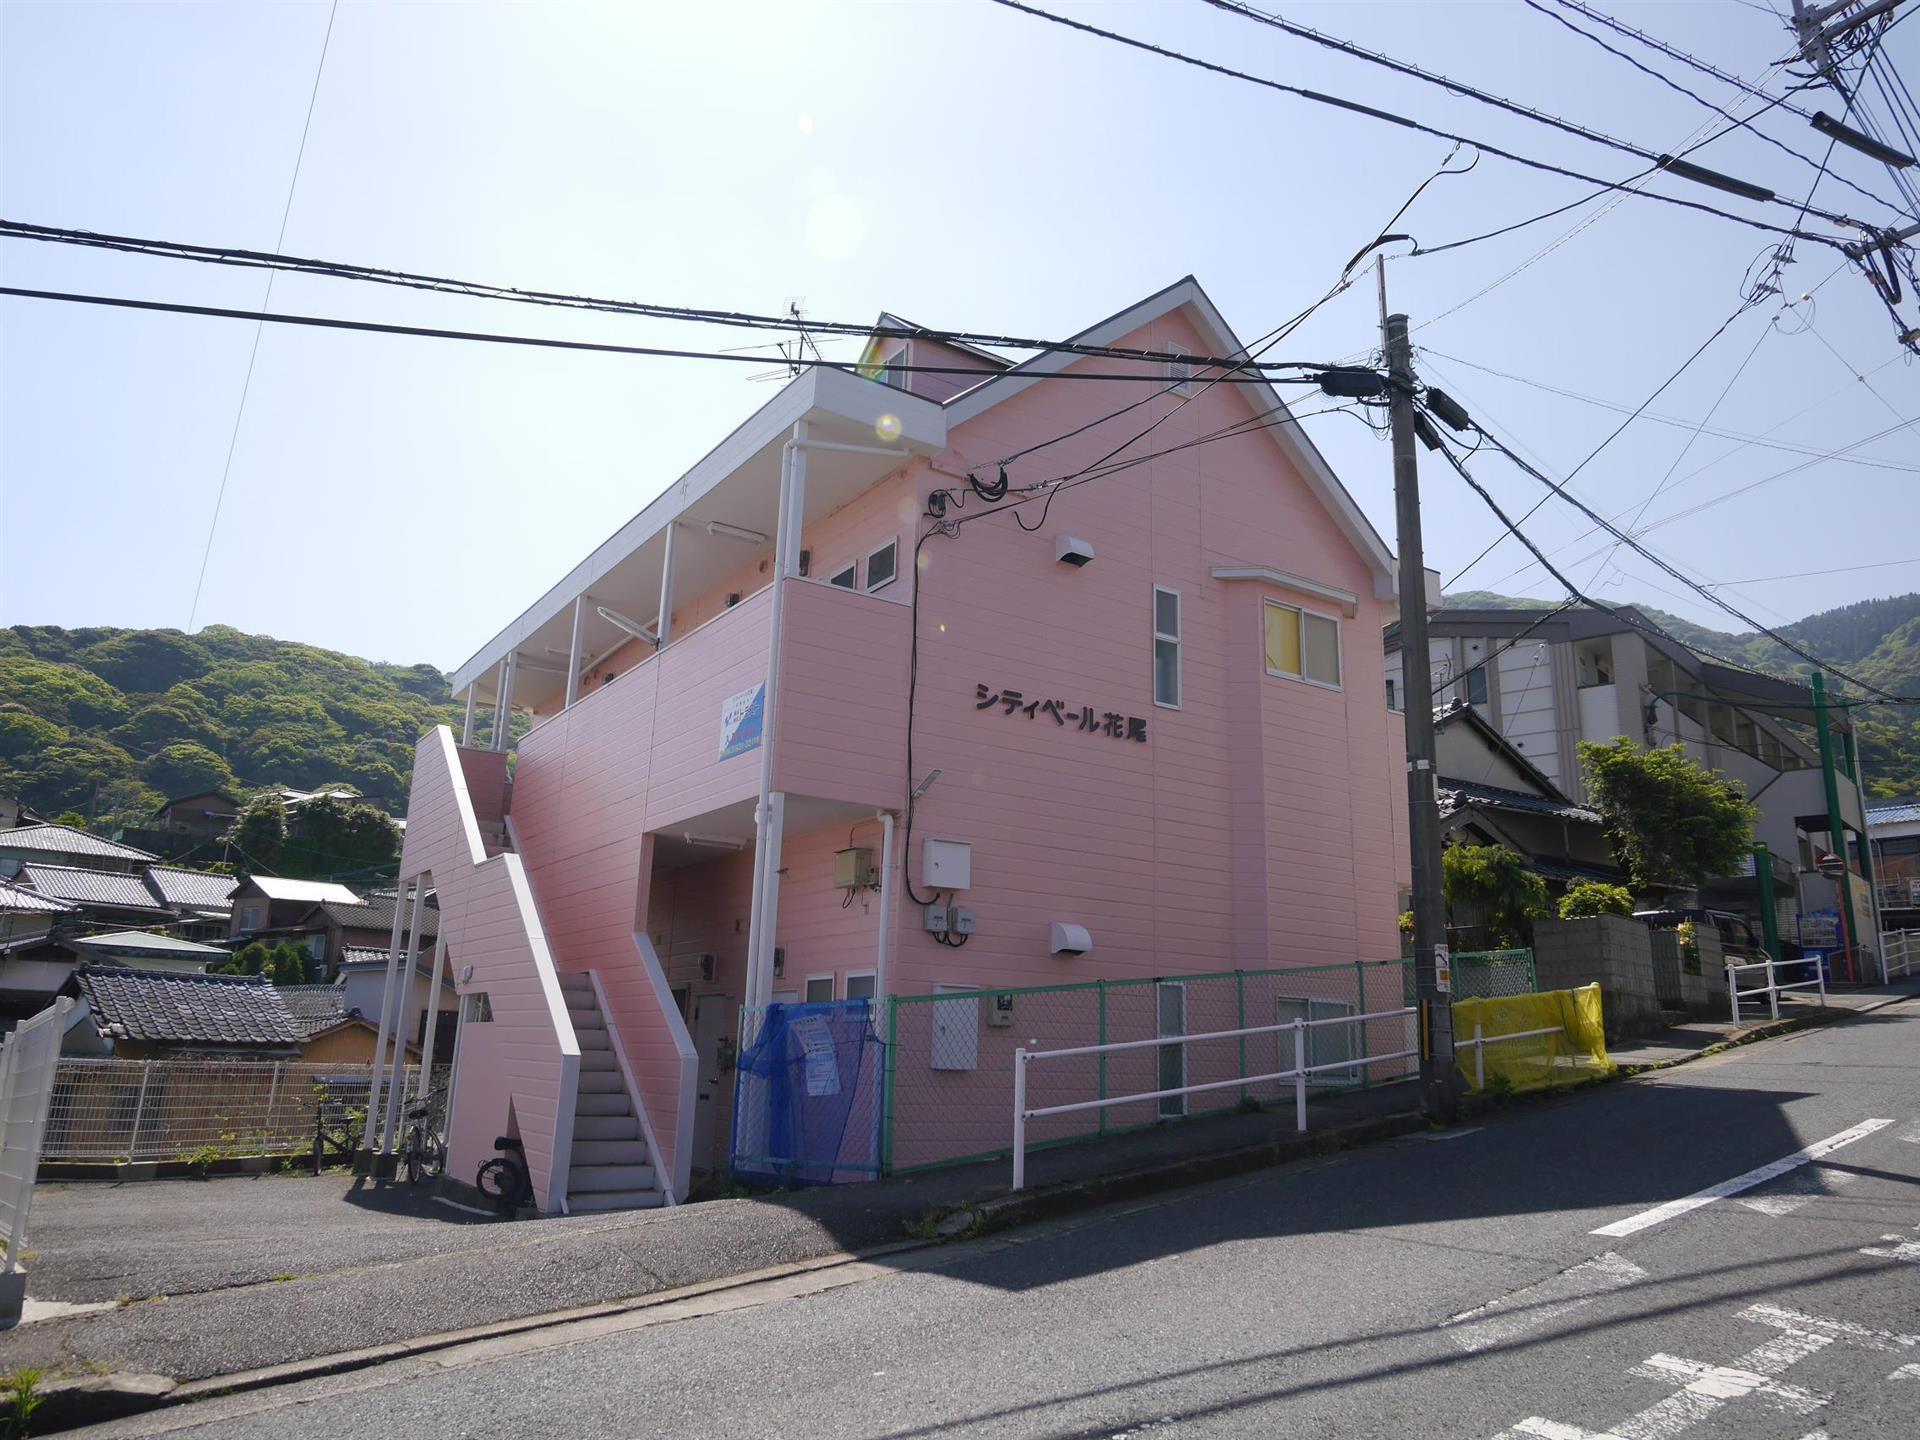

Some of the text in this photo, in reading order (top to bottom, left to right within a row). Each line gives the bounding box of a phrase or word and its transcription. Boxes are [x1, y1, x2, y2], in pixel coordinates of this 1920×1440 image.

[976, 683, 1147, 742] シティベール花尾
